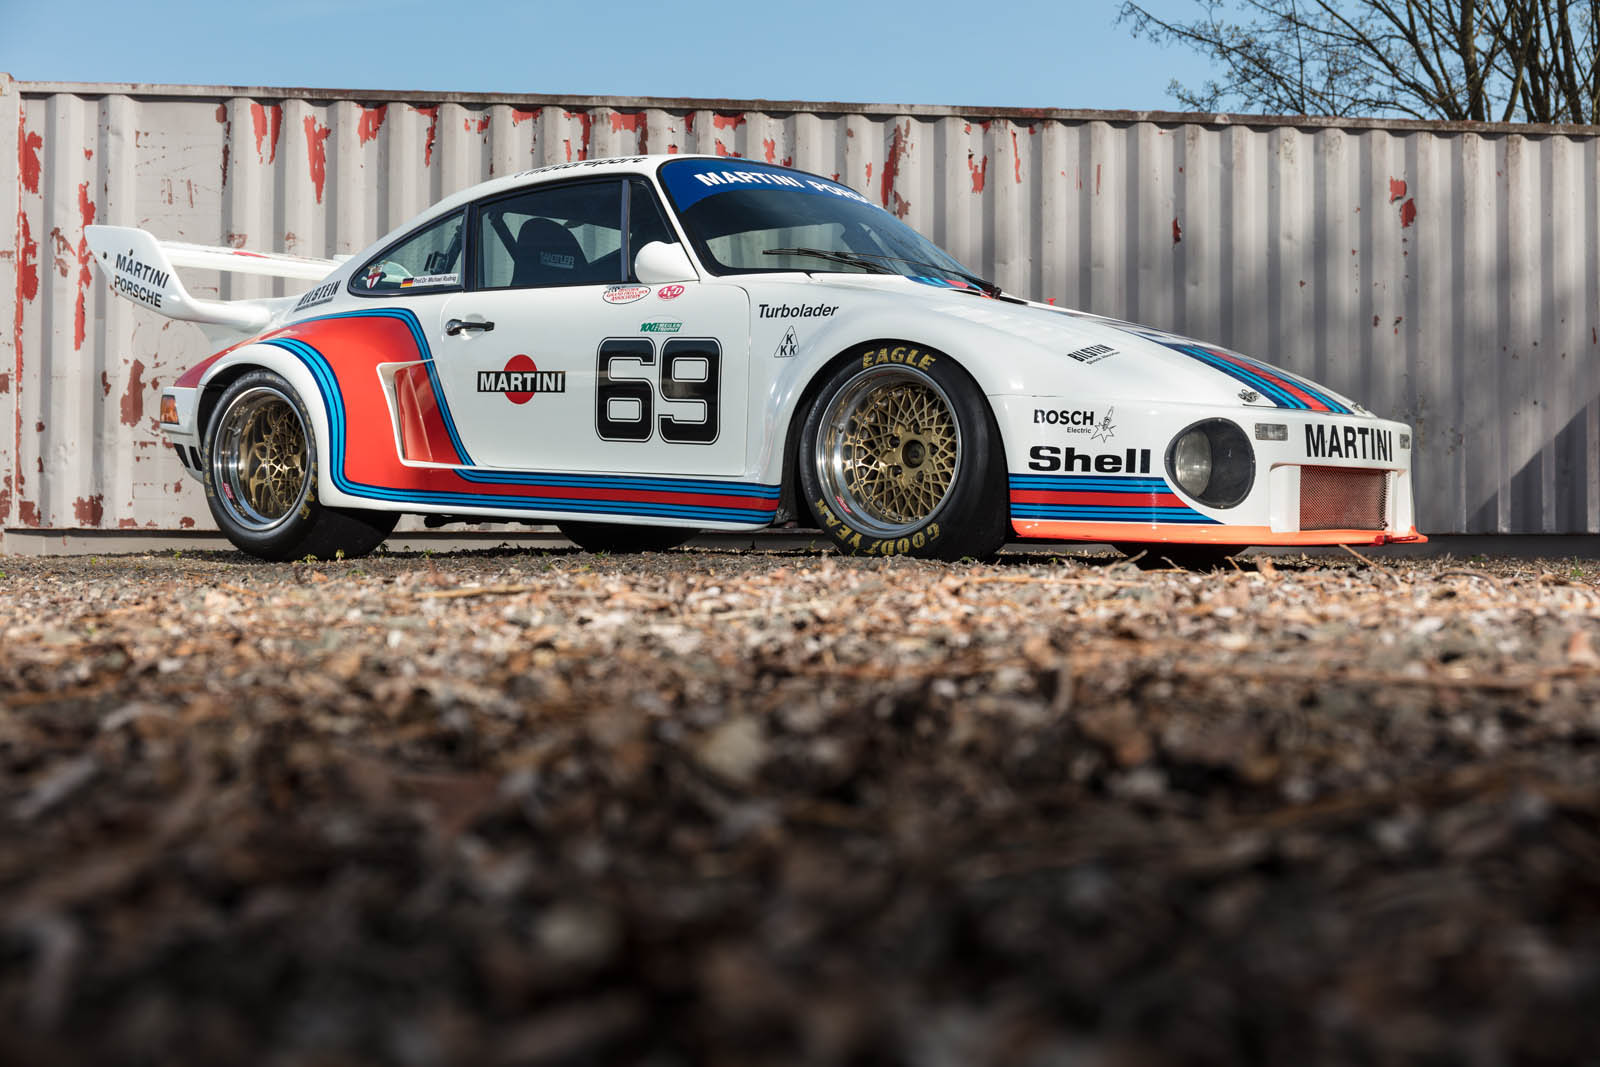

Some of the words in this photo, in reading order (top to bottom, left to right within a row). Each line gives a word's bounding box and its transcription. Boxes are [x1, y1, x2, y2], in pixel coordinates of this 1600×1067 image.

[693, 171, 805, 189] MARTINI
[115, 253, 171, 290] MARTINI
[114, 275, 163, 308] PORSCHE
[758, 303, 839, 318] Turbolader
[785, 333, 793, 345] K
[862, 346, 936, 371] EAGLE
[1067, 344, 1115, 362] BILSTEIN
[479, 372, 563, 391] MARTINI
[595, 337, 723, 445] 69
[1033, 409, 1094, 426] BOSCH
[1066, 426, 1091, 434] Electric
[1304, 423, 1393, 462] MARTINI
[1028, 445, 1151, 474] Shell
